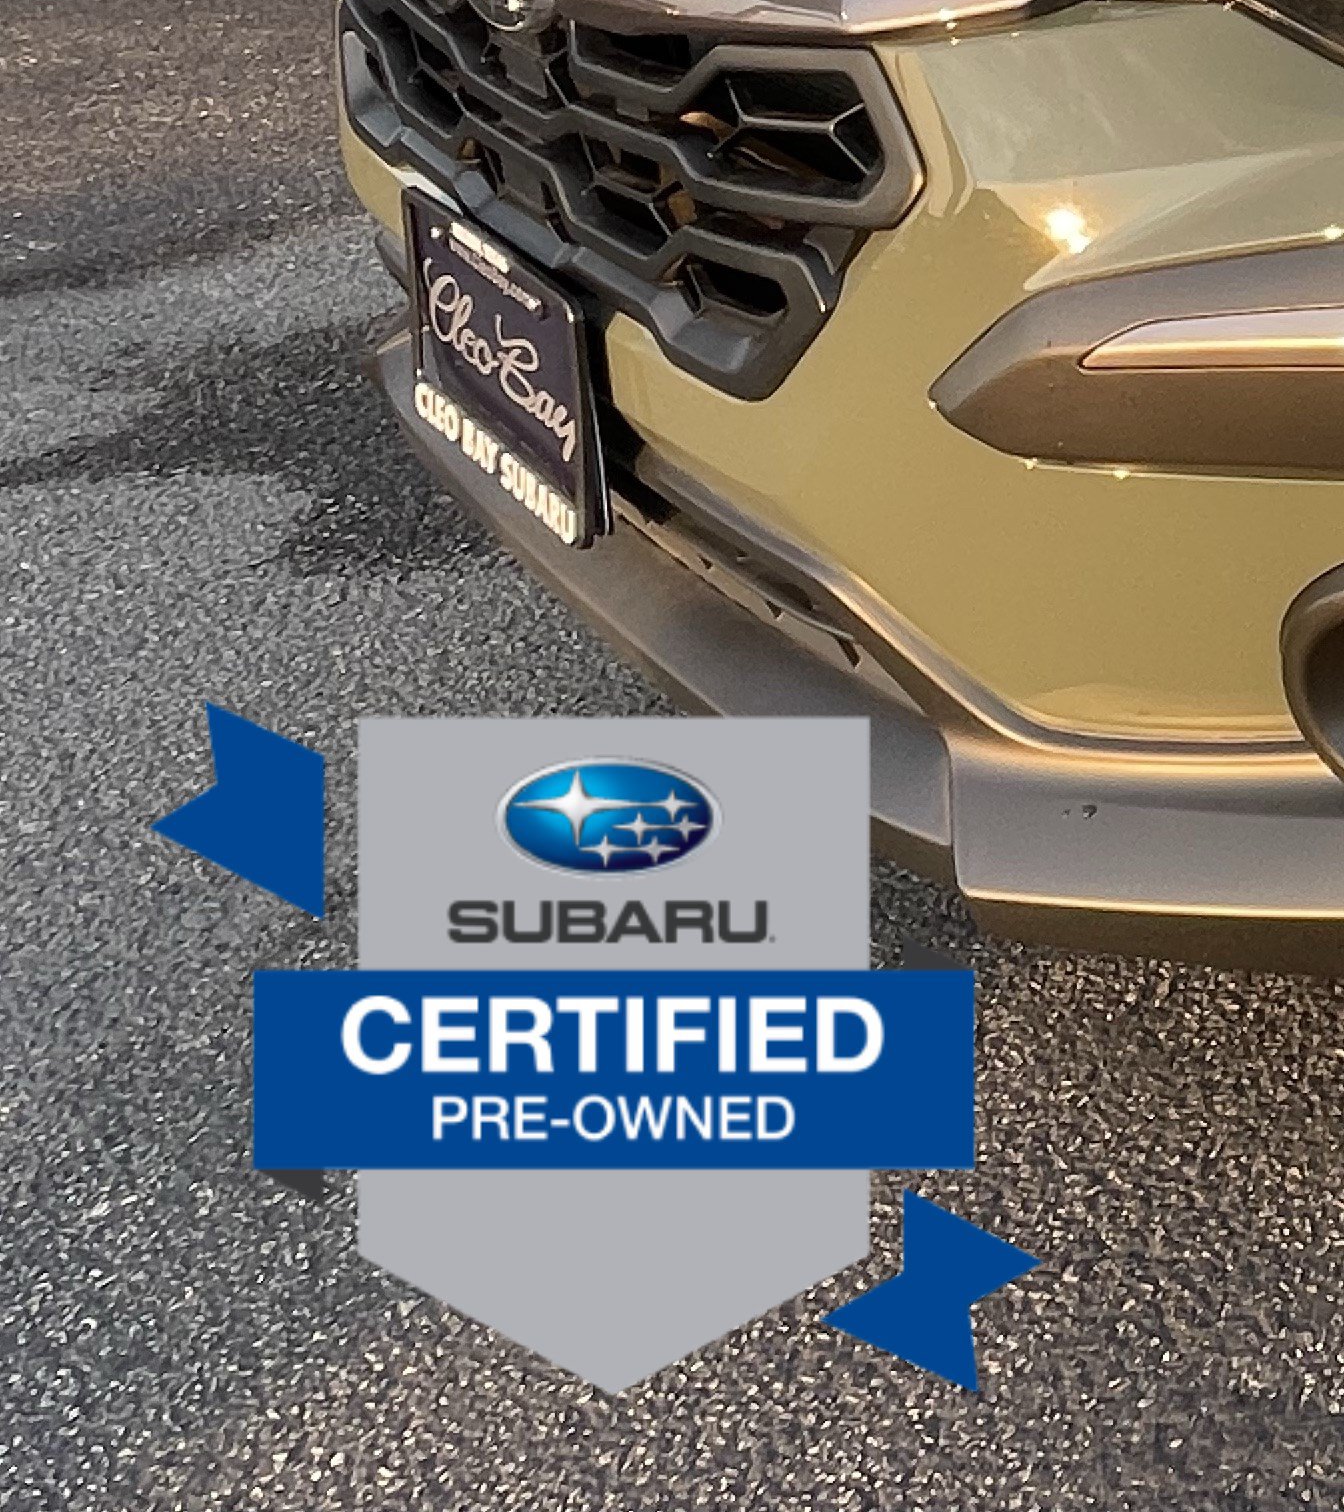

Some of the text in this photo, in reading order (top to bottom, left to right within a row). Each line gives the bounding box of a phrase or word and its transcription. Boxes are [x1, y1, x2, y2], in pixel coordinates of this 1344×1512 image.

[414, 382, 578, 544] CLEO BAY SUBARU
